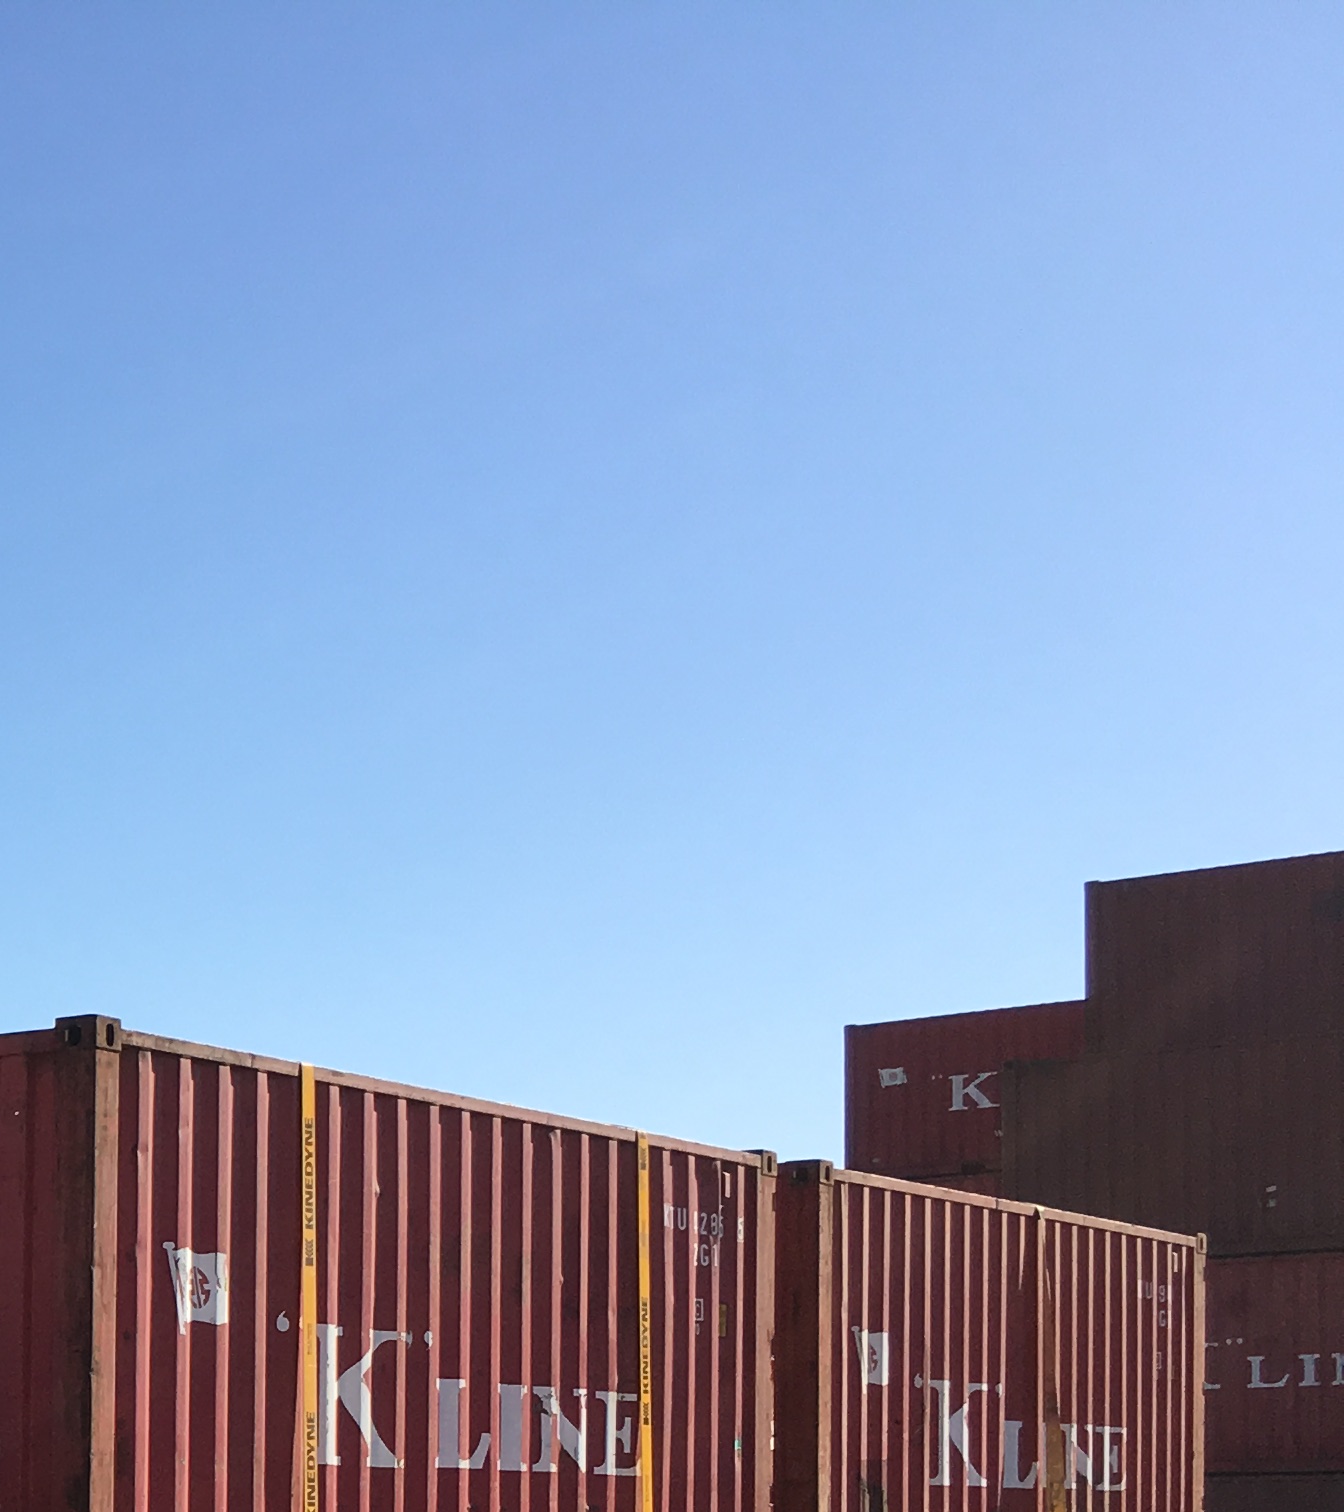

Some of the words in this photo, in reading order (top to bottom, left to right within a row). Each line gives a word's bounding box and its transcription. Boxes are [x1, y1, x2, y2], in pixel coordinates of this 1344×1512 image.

[304, 1117, 314, 1229] KINEDYNE
[435, 1378, 642, 1476] LINE
[1003, 1420, 1127, 1491] LNE
